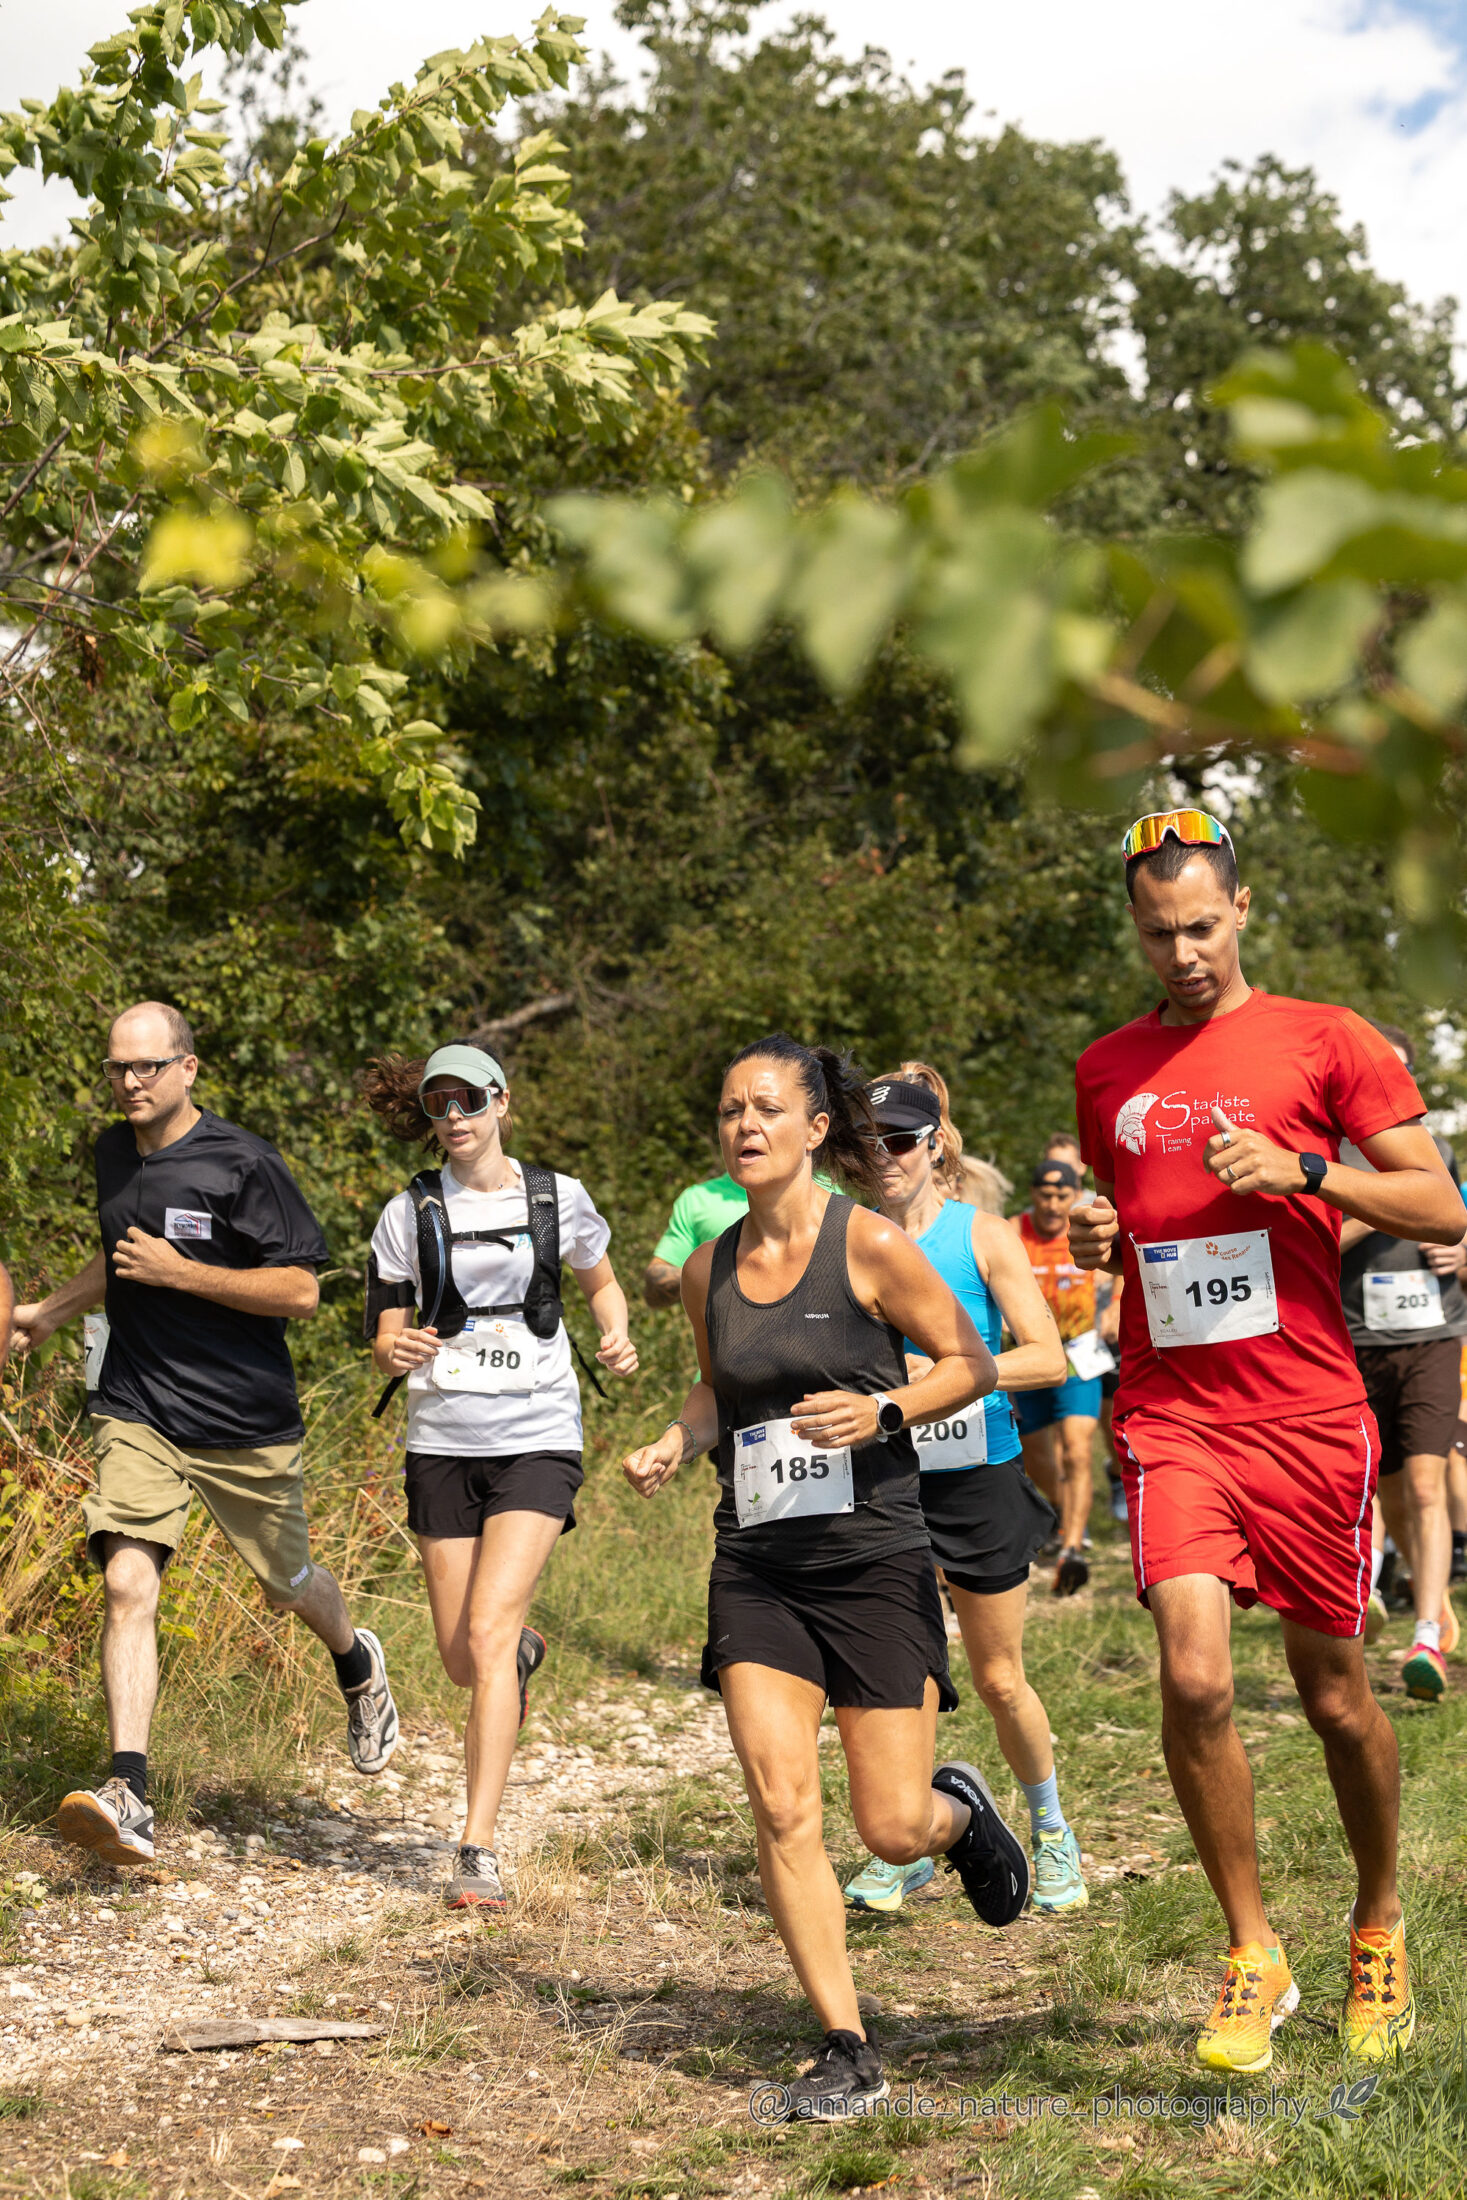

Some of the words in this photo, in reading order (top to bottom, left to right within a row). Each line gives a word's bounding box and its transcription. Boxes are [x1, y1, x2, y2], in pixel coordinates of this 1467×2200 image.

[1185, 1275, 1252, 1307] 195
[1396, 1294, 1429, 1309] 203
[476, 1348, 521, 1370] 180
[916, 1420, 968, 1443] 200
[770, 1454, 829, 1484] 185
[951, 1775, 984, 1812] HOKA
